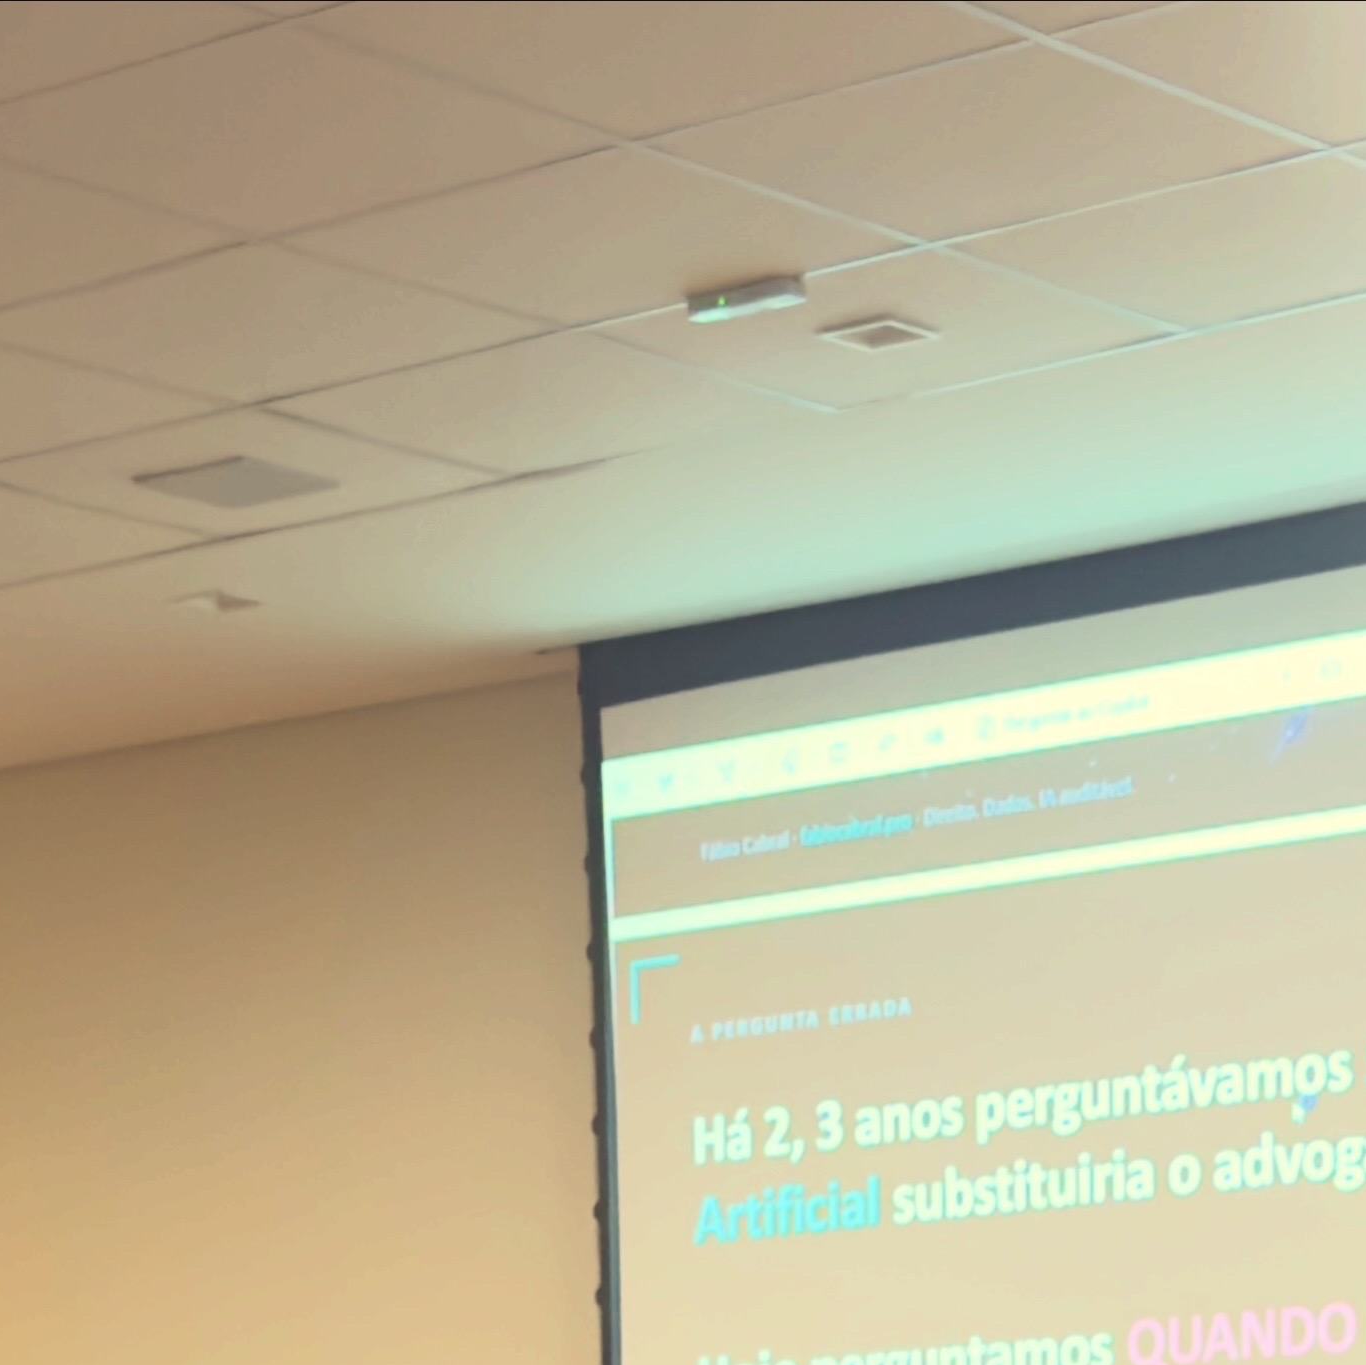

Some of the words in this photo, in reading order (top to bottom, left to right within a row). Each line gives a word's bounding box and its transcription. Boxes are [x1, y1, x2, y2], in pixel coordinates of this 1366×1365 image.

[742, 830, 790, 856] Cabral
[690, 1023, 705, 1044] A
[711, 1009, 819, 1041] PERGUNTA
[828, 996, 912, 1026] ERRADA
[692, 1107, 753, 1166] Há
[763, 1104, 806, 1165] 2,
[814, 1098, 845, 1152] 3
[853, 1093, 965, 1148] anos
[974, 1048, 1354, 1146] perguntávamos
[692, 1173, 882, 1246] Artificial
[891, 1147, 1156, 1226] substituiria
[1167, 1152, 1202, 1196] o
